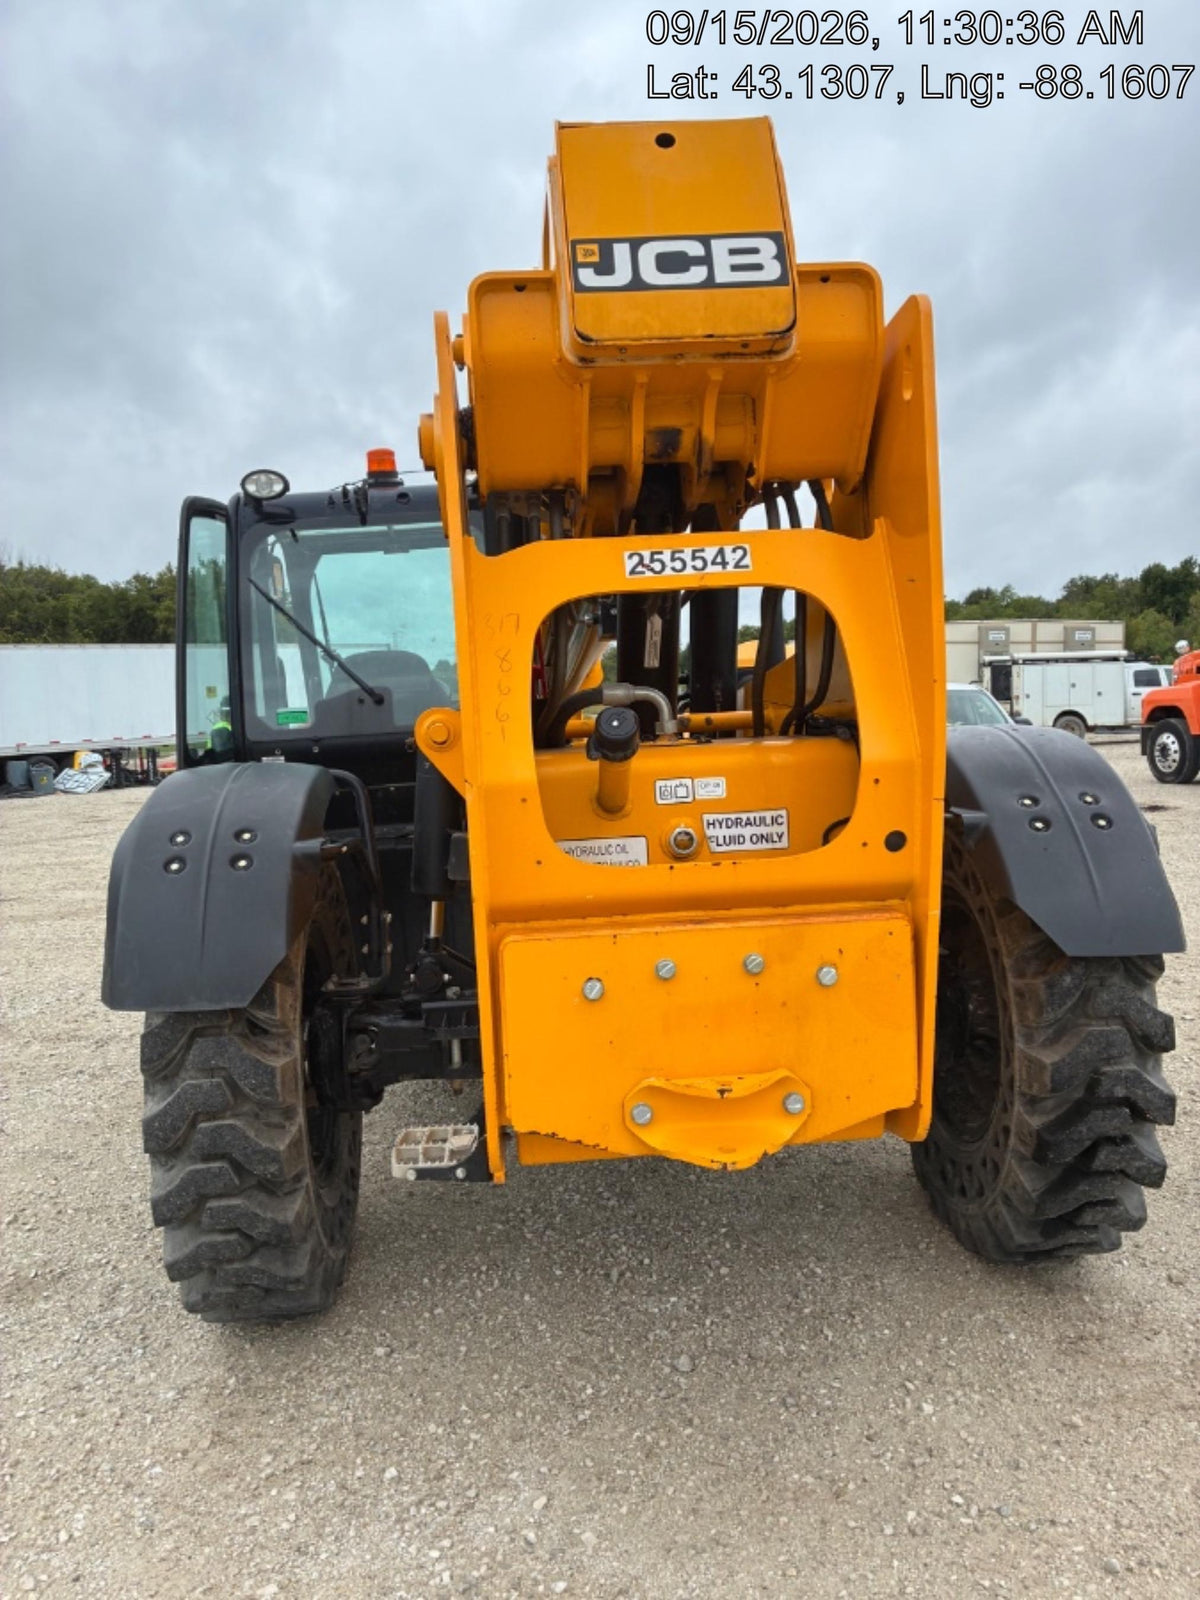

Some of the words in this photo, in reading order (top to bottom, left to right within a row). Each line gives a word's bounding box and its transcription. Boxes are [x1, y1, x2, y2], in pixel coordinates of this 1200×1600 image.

[577, 237, 782, 287] JCB
[627, 545, 750, 576] 255542
[706, 814, 784, 830] HYDRAULIC
[749, 831, 785, 846] ONLY
[615, 843, 630, 855] OIL
